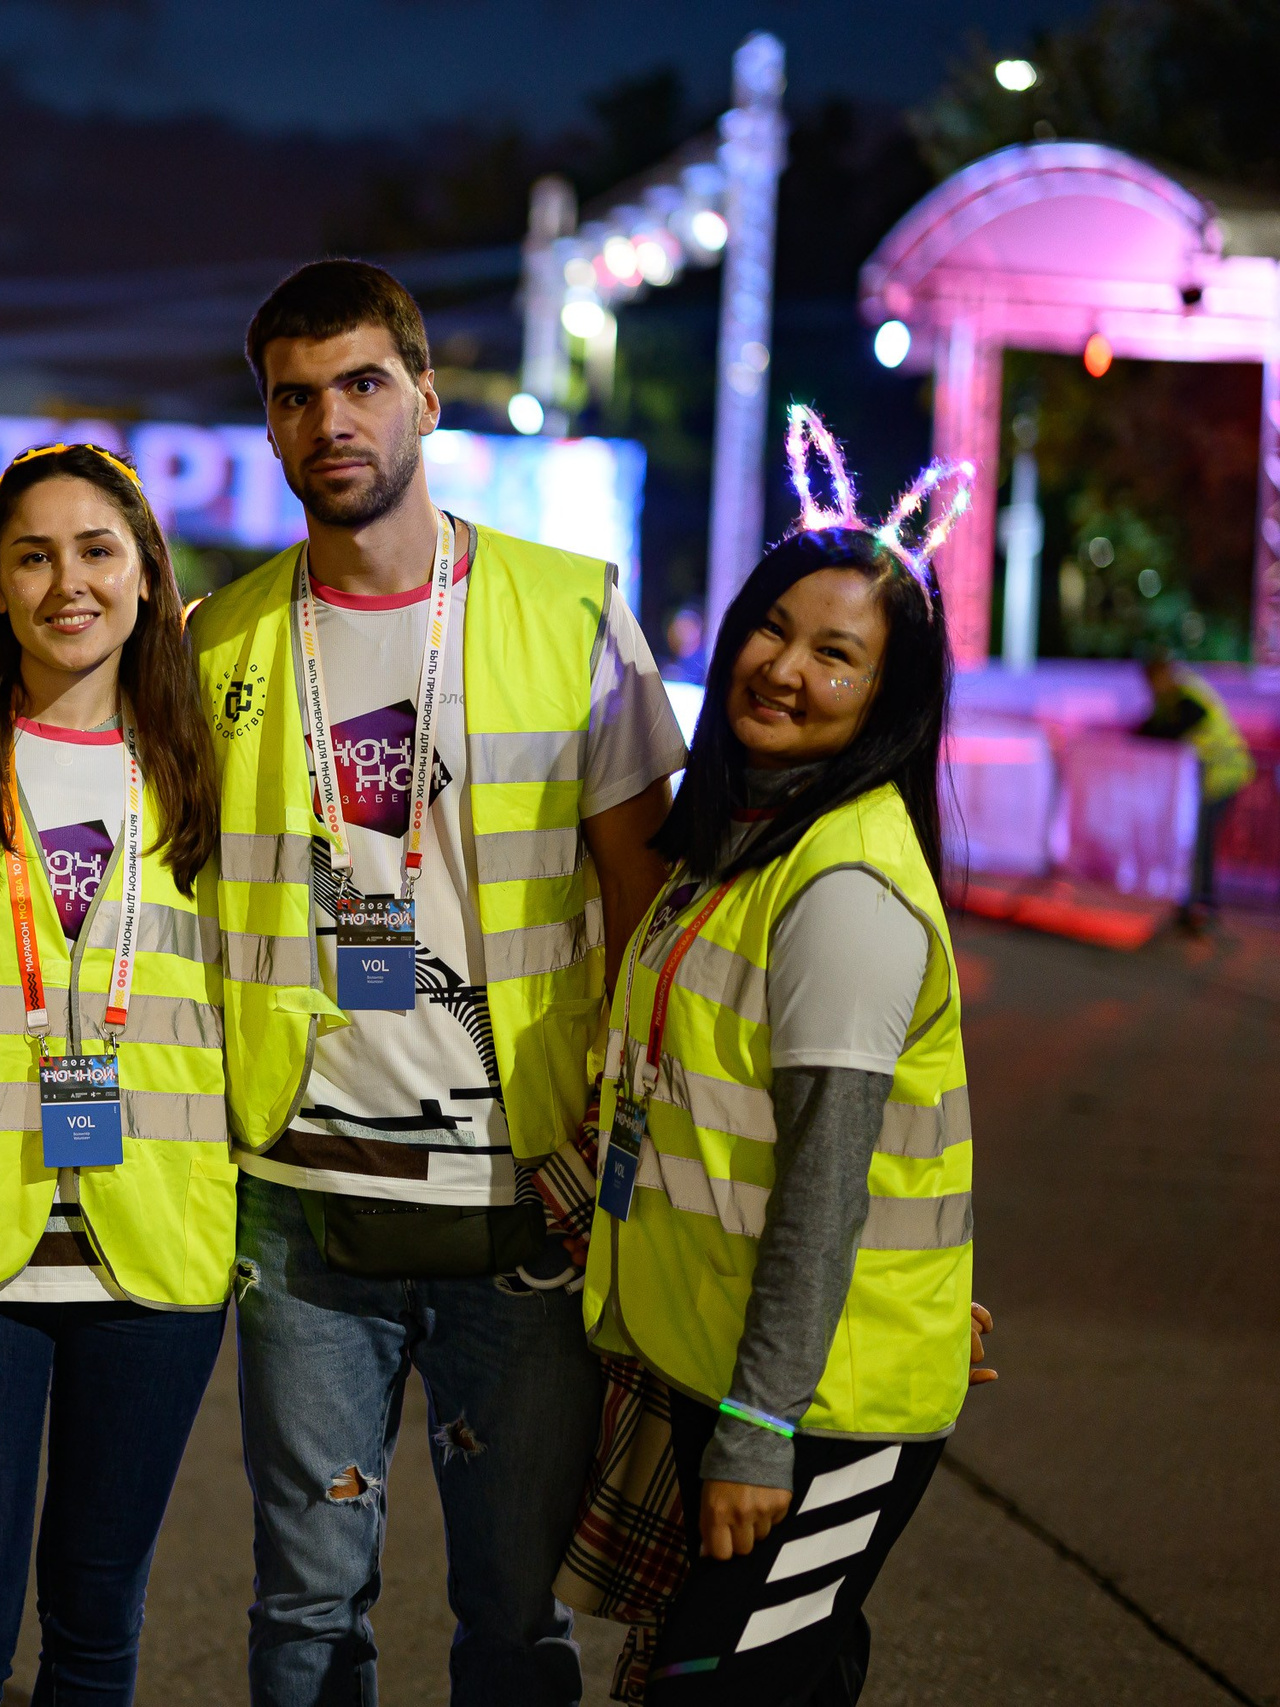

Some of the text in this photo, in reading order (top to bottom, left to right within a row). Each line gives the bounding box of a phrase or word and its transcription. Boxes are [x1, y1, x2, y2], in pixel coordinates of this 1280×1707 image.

[438, 572, 447, 589] ЛЕТ
[308, 659, 334, 804] БЫТЬ ПРИМЕРОМ ДЛЯ МНОГИХ
[416, 650, 438, 798] БЫТЬ ПРИМЕРОМ ДЛЯ МНОГИХ
[122, 814, 138, 957] БЫТЬ ПРИМЕРОМ ДЛЯ МНОГИХ
[15, 878, 28, 919] МОСКВА
[359, 902, 391, 910] 2024
[338, 911, 412, 926] НОЧНОЙ
[20, 922, 34, 972] МАРАФОН
[361, 959, 390, 972] VOL
[655, 975, 670, 1026] МАРАФОН
[666, 934, 692, 973] МОСКВА
[62, 1059, 94, 1067] 2024
[41, 1066, 116, 1083] НОЧНОЙ
[67, 1116, 96, 1129] VOL
